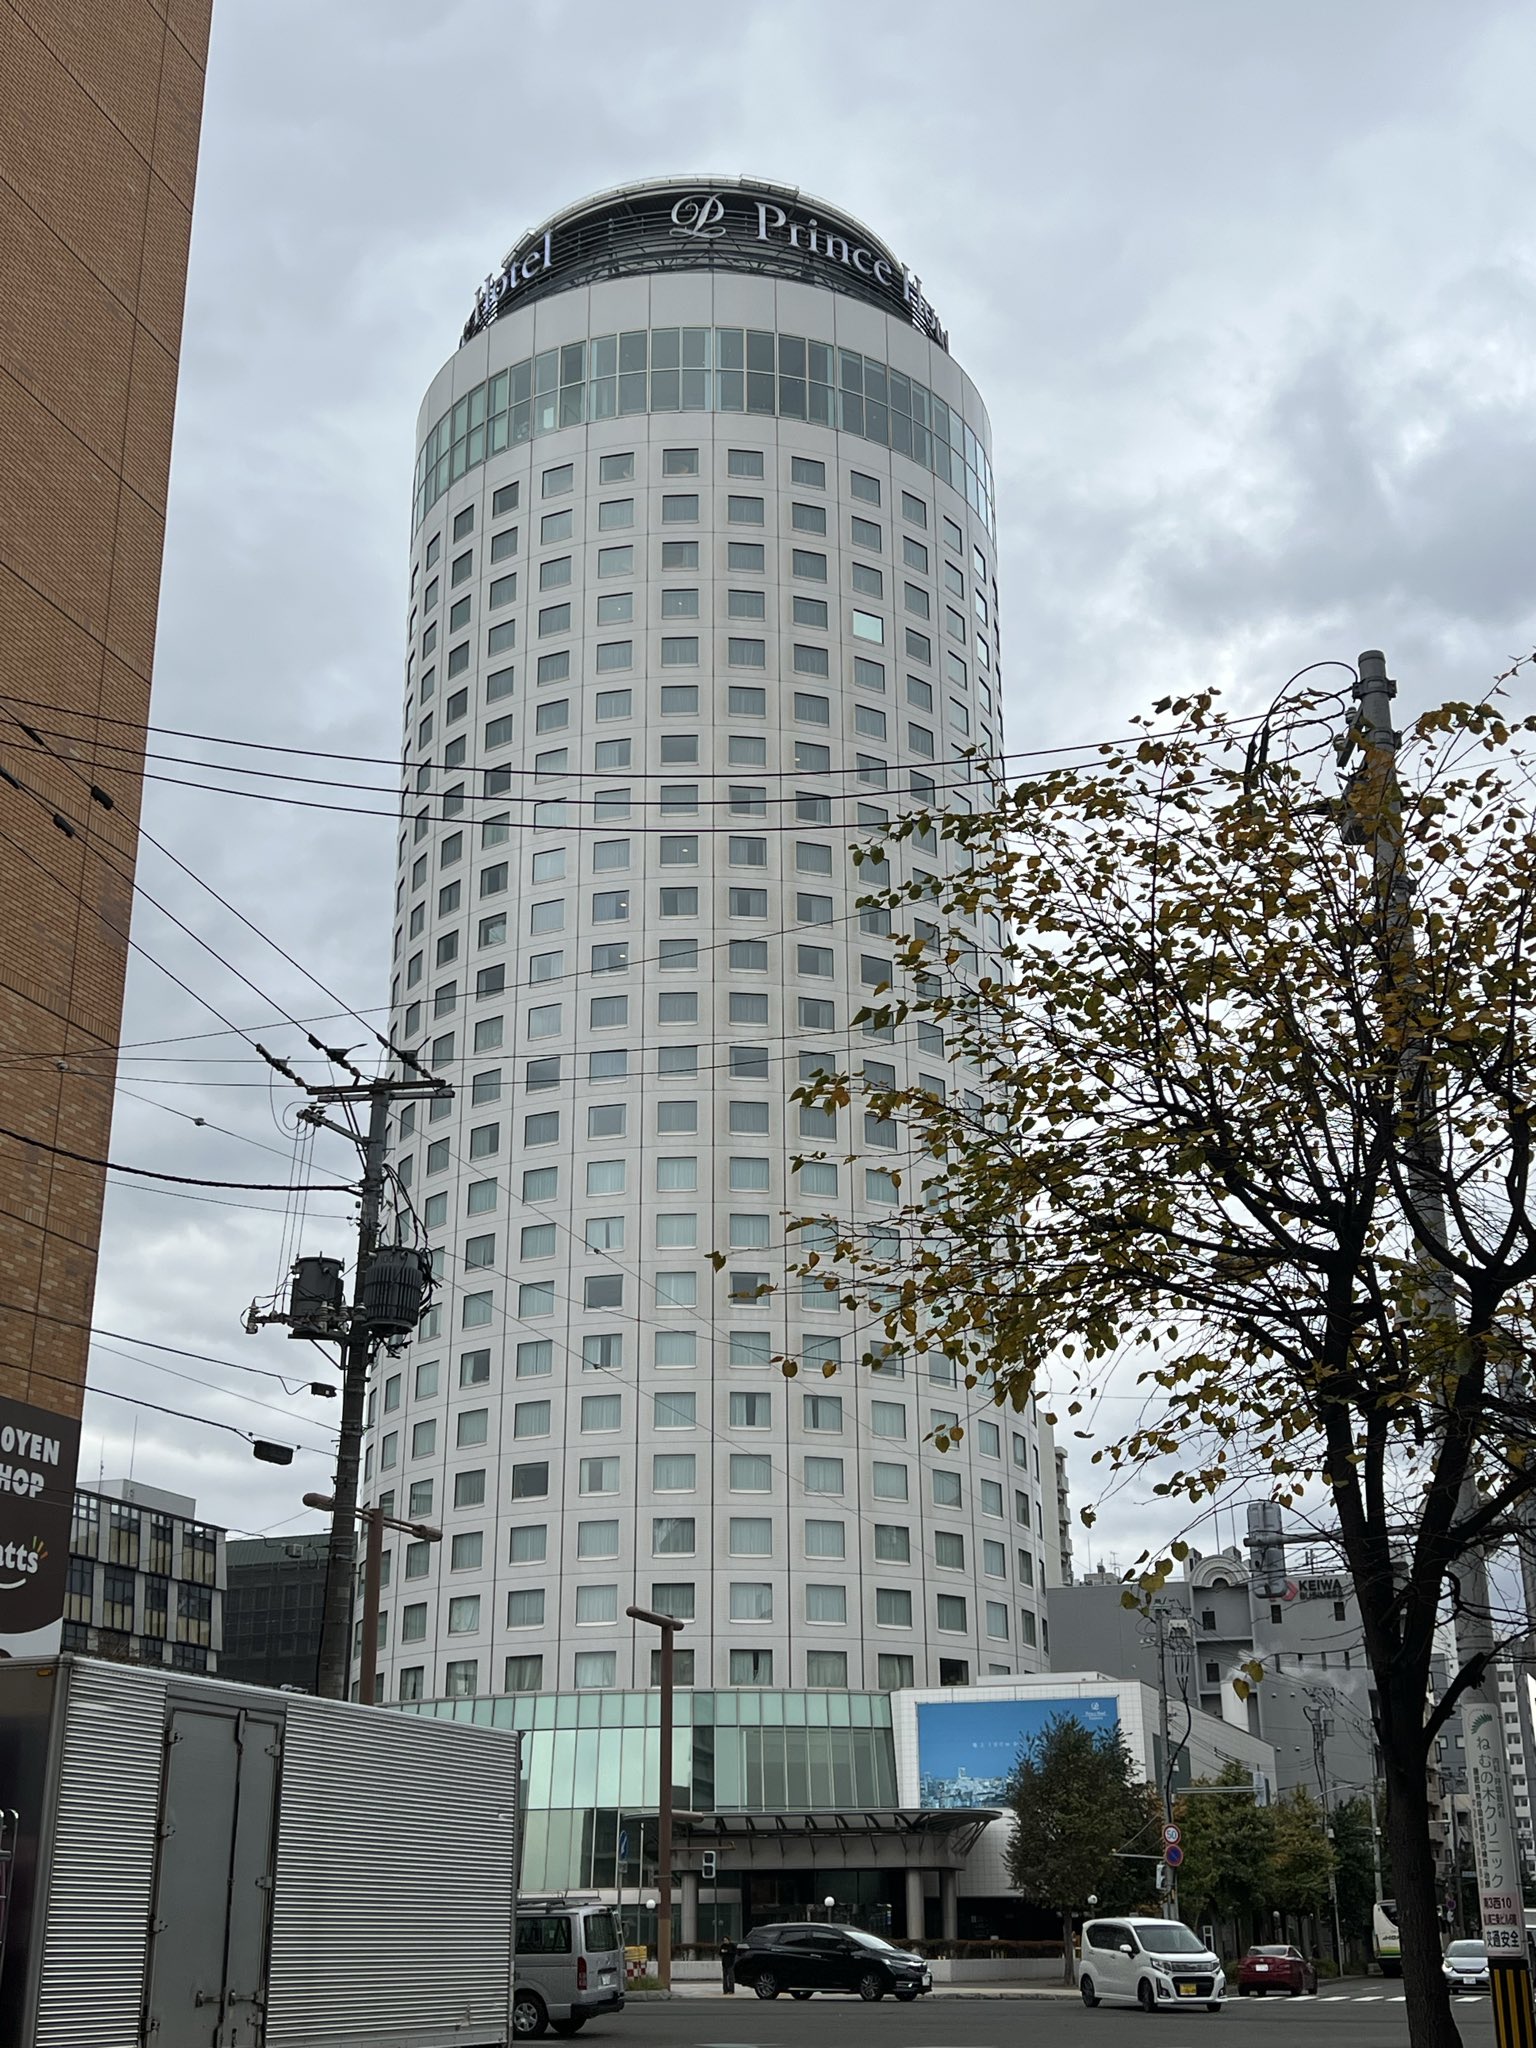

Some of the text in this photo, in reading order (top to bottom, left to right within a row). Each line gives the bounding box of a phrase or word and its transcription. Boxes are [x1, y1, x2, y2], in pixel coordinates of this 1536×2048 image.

[754, 201, 893, 287] Prince
[1298, 1579, 1342, 1591] KEIWA
[1166, 1829, 1177, 1840] 50
[1477, 1736, 1504, 1888] ねむの木クリニック
